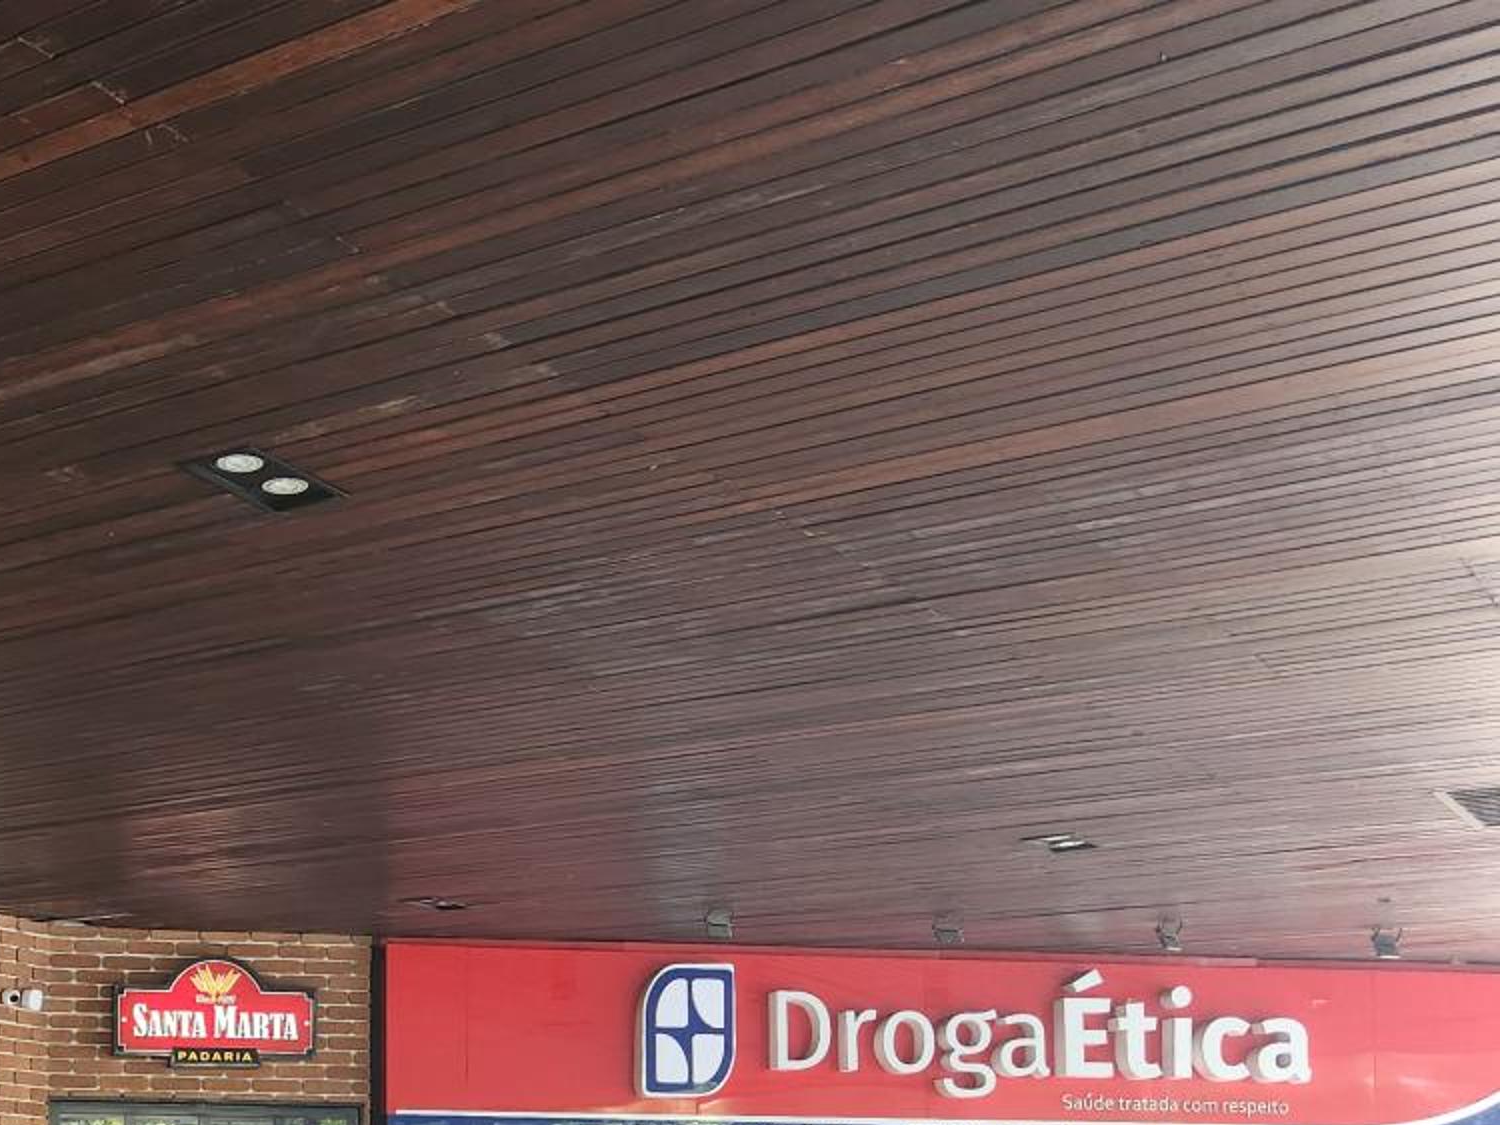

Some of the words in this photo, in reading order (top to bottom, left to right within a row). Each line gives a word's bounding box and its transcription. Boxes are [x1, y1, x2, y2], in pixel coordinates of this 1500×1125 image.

[132, 1003, 207, 1038] SANTA
[213, 1005, 298, 1040] MARTA
[767, 968, 1313, 1098] DrogaÉtica
[177, 1051, 252, 1062] PADARIA
[1062, 1094, 1114, 1111] Saúde
[1118, 1097, 1178, 1112] tratada
[1183, 1101, 1218, 1113] com
[1223, 1100, 1290, 1117] respeito
